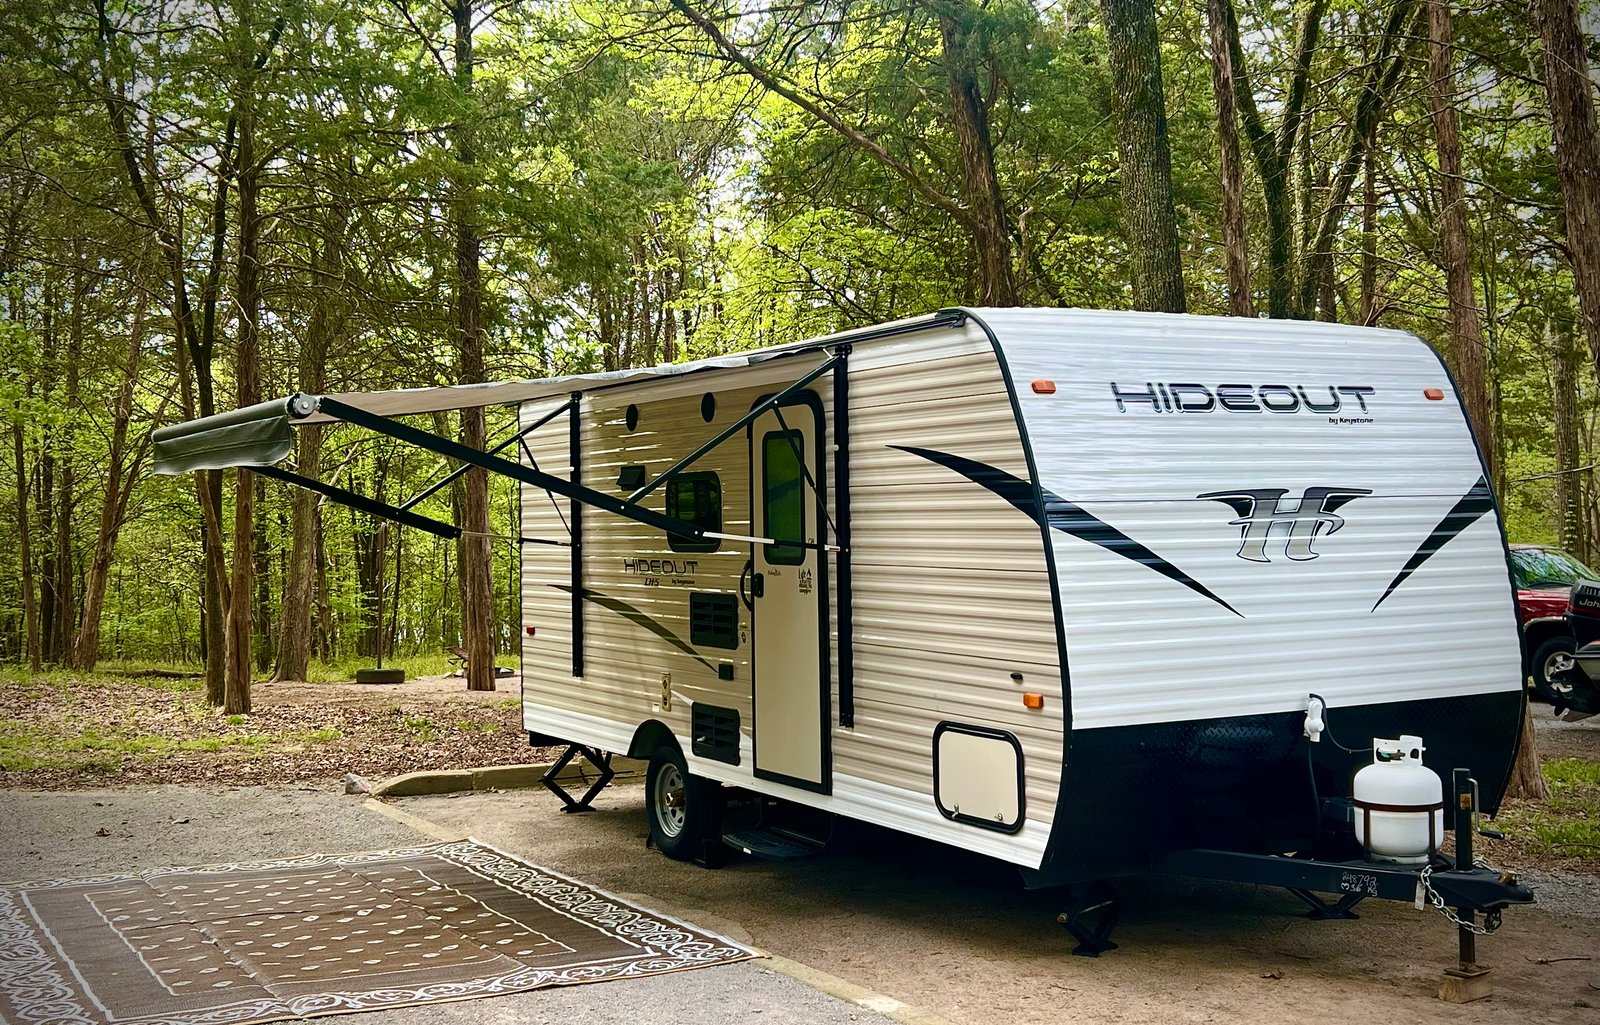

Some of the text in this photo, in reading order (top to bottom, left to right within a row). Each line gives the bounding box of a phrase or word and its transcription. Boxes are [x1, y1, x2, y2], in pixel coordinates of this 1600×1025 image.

[1110, 382, 1376, 413] HIDEOUT
[1328, 417, 1374, 425] by Keystone
[623, 558, 699, 576] HIDEOUT
[1579, 598, 1600, 609] Joh
